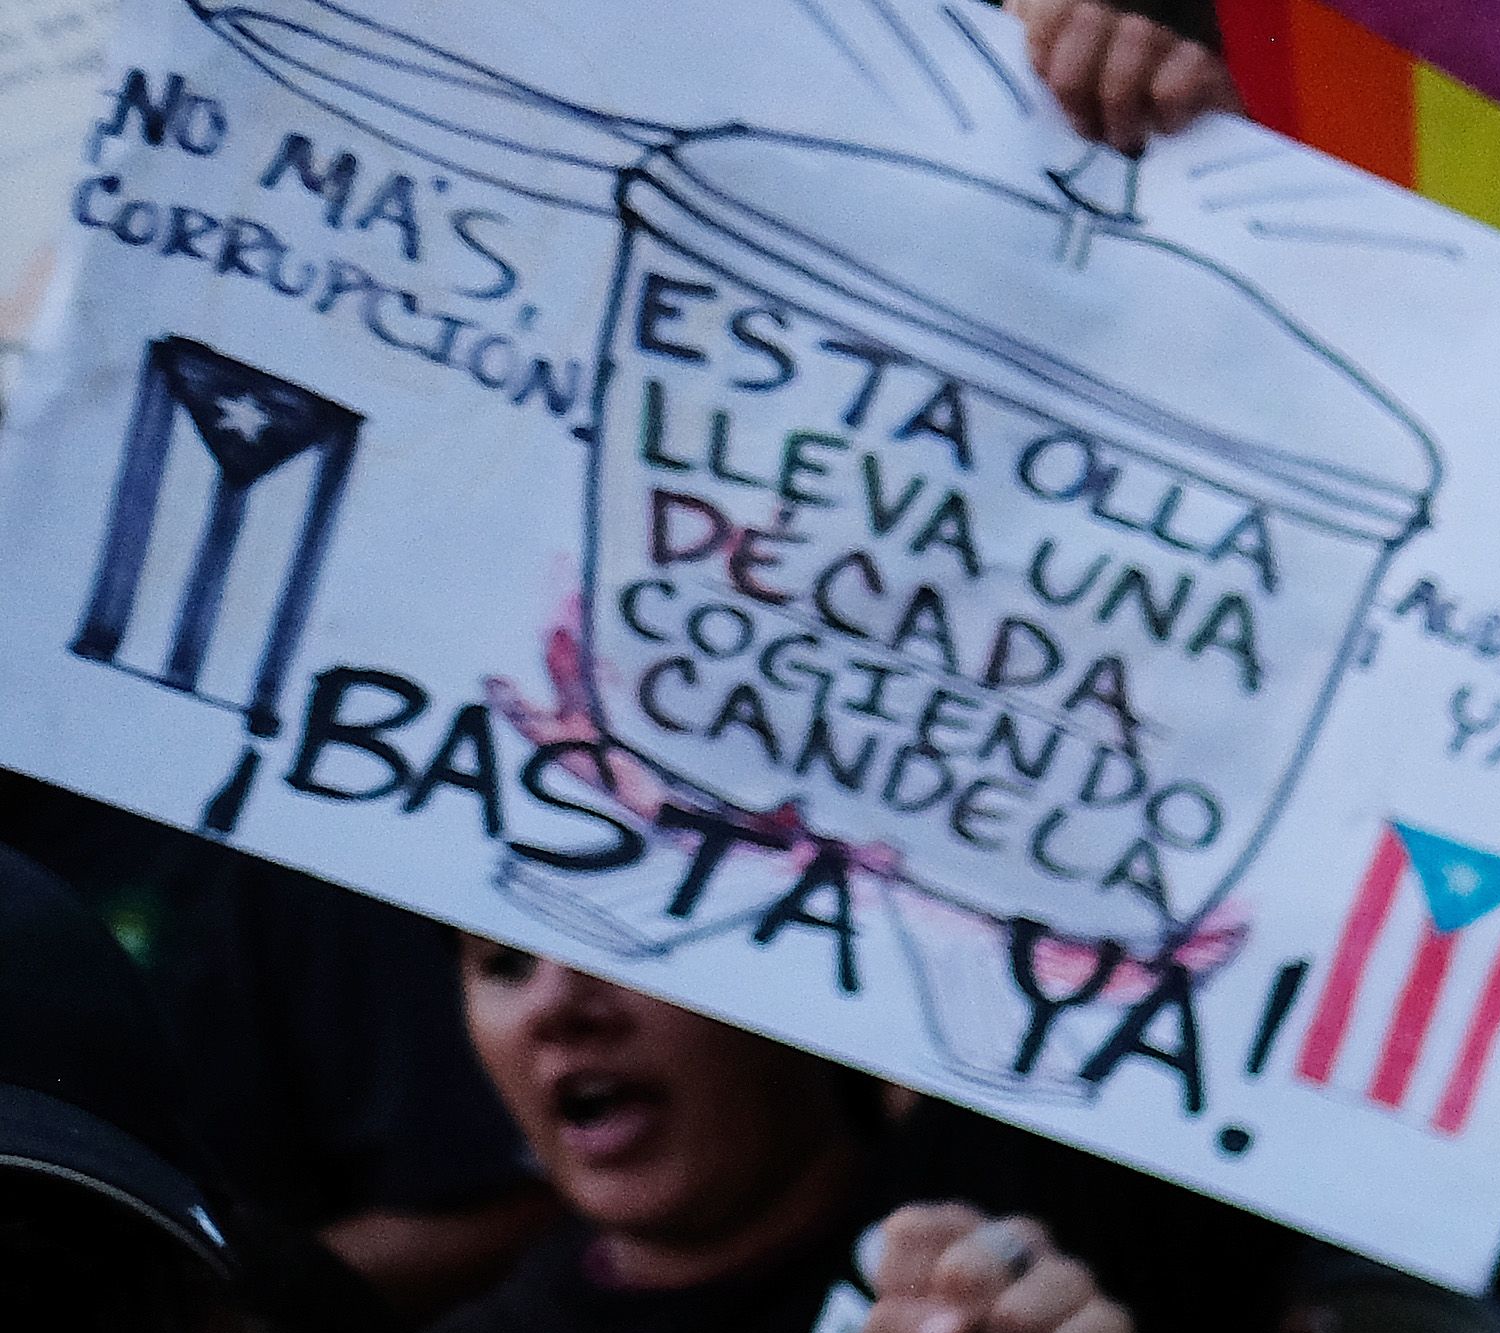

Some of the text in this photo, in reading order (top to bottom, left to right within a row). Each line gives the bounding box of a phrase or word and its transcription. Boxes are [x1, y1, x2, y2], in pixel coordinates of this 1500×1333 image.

[636, 271, 1280, 593] ESTA OLLA
[640, 380, 1264, 696] LLEVA UNA
[617, 578, 1224, 851] COGIENDO
[639, 655, 1172, 912] CANDELA
[1009, 916, 1312, 1158] YA!
